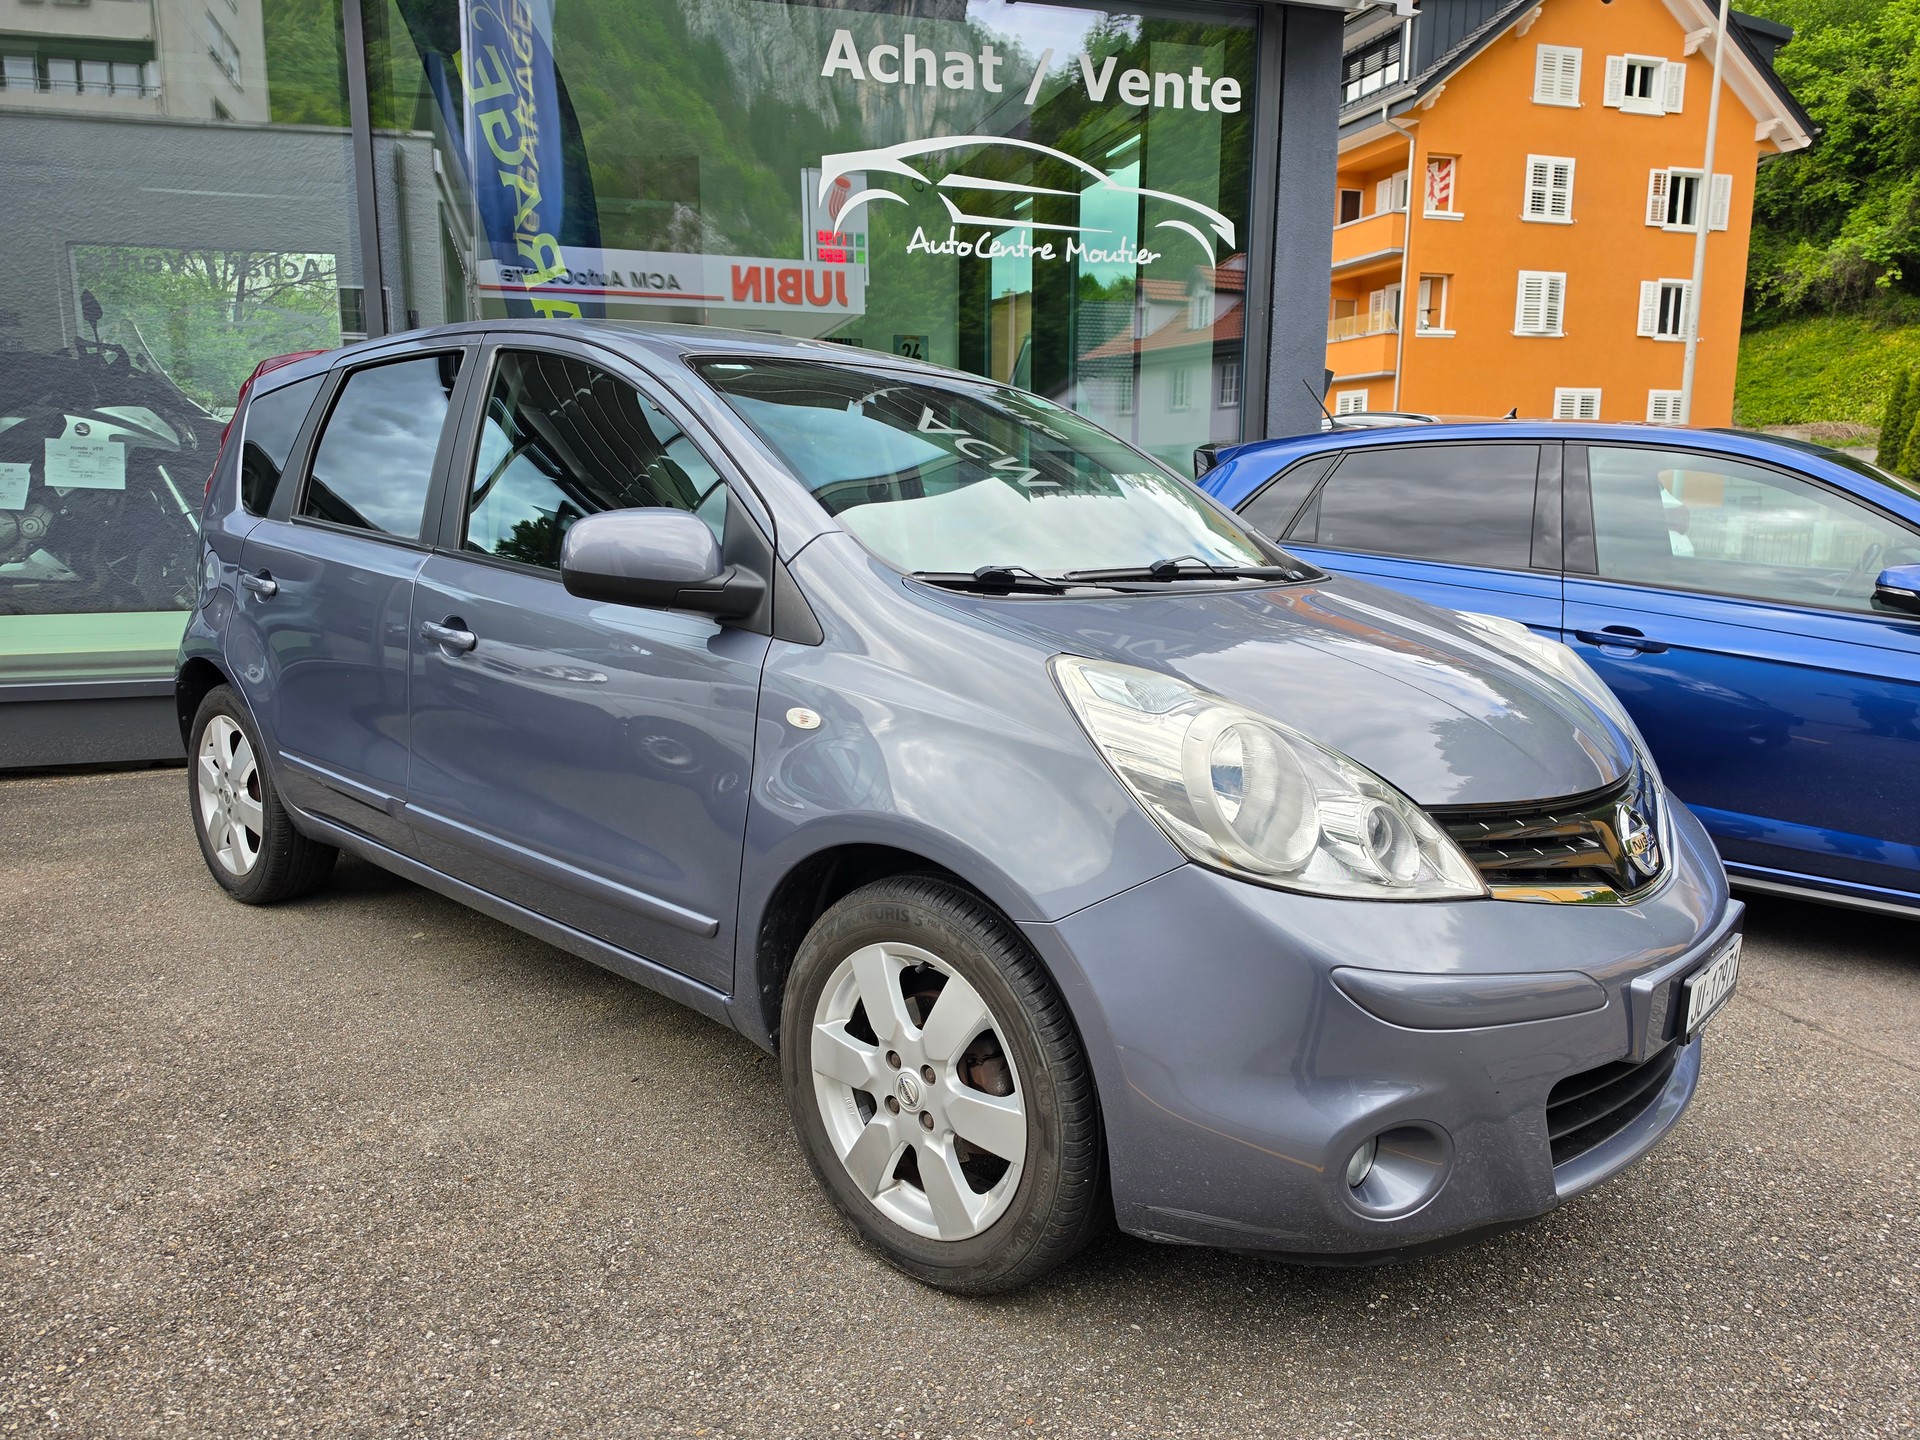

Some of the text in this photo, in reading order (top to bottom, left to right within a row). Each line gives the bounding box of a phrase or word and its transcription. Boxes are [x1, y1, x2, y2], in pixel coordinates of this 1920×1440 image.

[820, 28, 1242, 113] Achat / Vente
[906, 226, 1162, 264] AutoCentre Moutier
